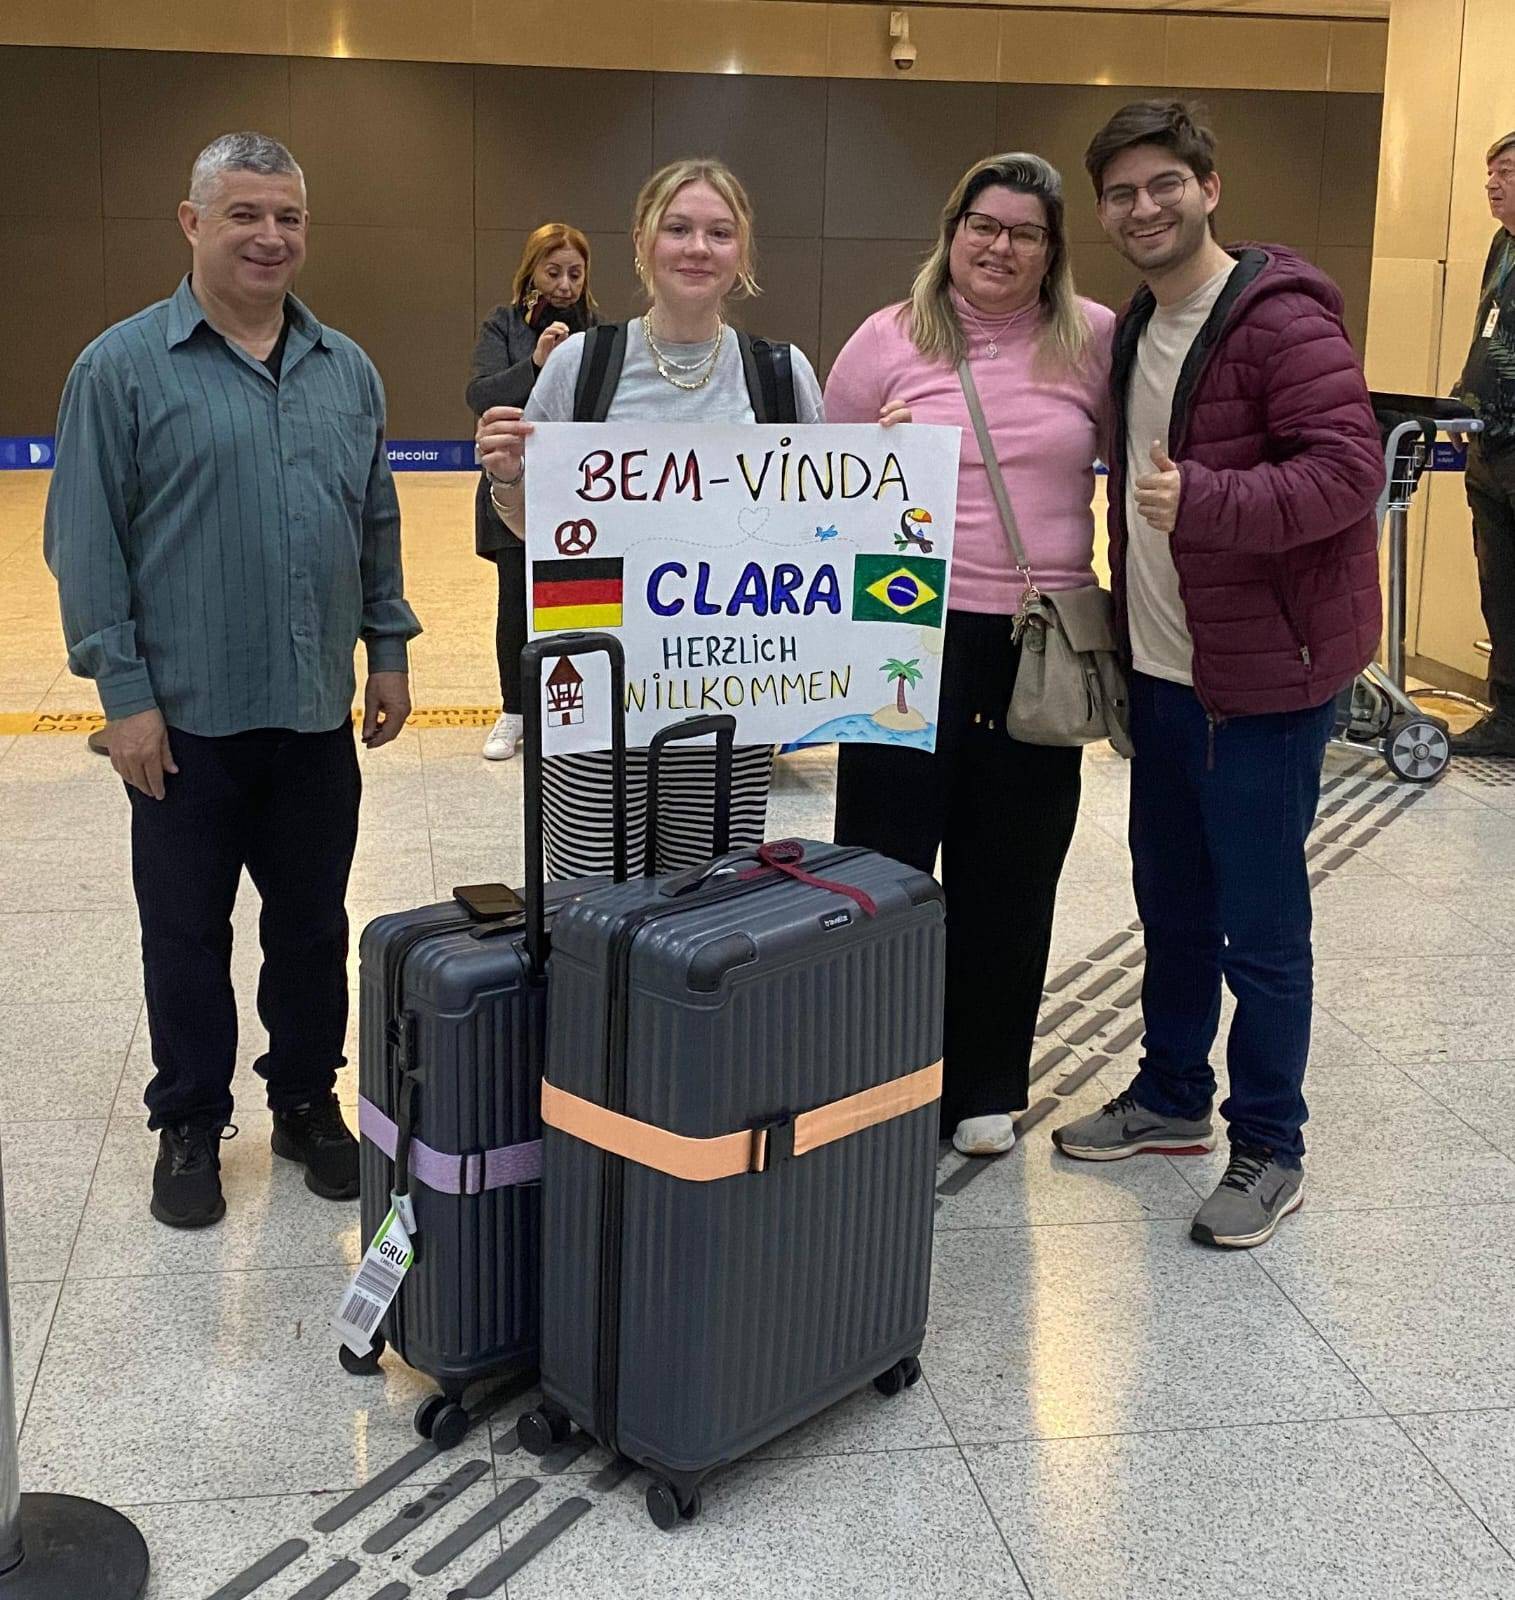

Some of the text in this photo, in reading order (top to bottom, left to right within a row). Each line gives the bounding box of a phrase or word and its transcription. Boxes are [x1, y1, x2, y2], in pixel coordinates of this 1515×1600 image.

[387, 450, 439, 461] decolar
[646, 561, 842, 617] CLARA
[662, 633, 798, 670] HERZLICH
[624, 664, 852, 713] WILLKOMMEN
[33, 724, 77, 732] Do
[379, 1241, 408, 1265] GRU
